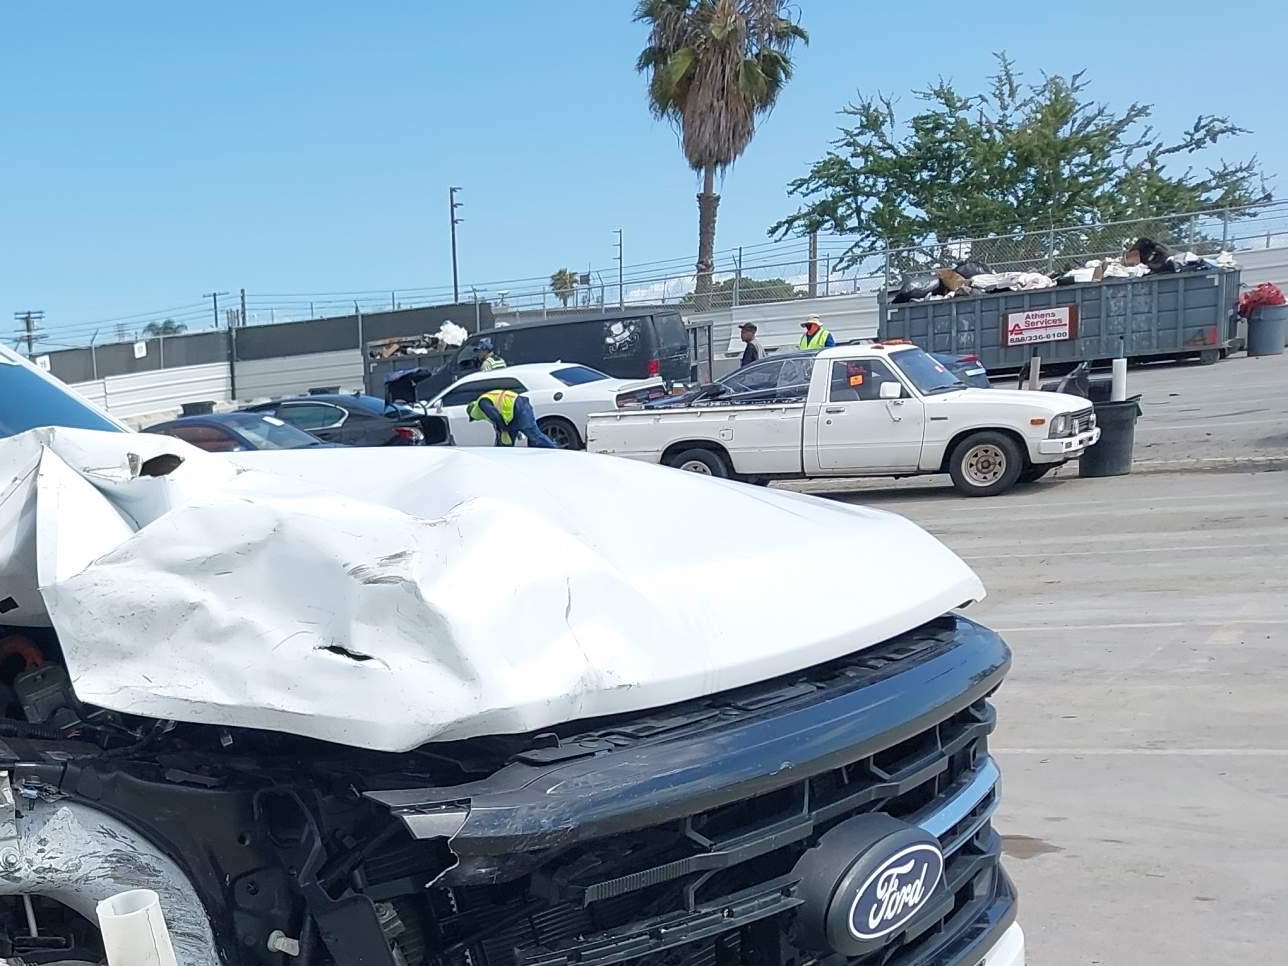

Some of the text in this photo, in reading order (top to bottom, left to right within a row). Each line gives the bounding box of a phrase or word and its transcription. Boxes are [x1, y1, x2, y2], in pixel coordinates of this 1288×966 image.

[1025, 311, 1056, 320] Athens
[1024, 317, 1063, 328] Services
[868, 859, 929, 930] Ford
